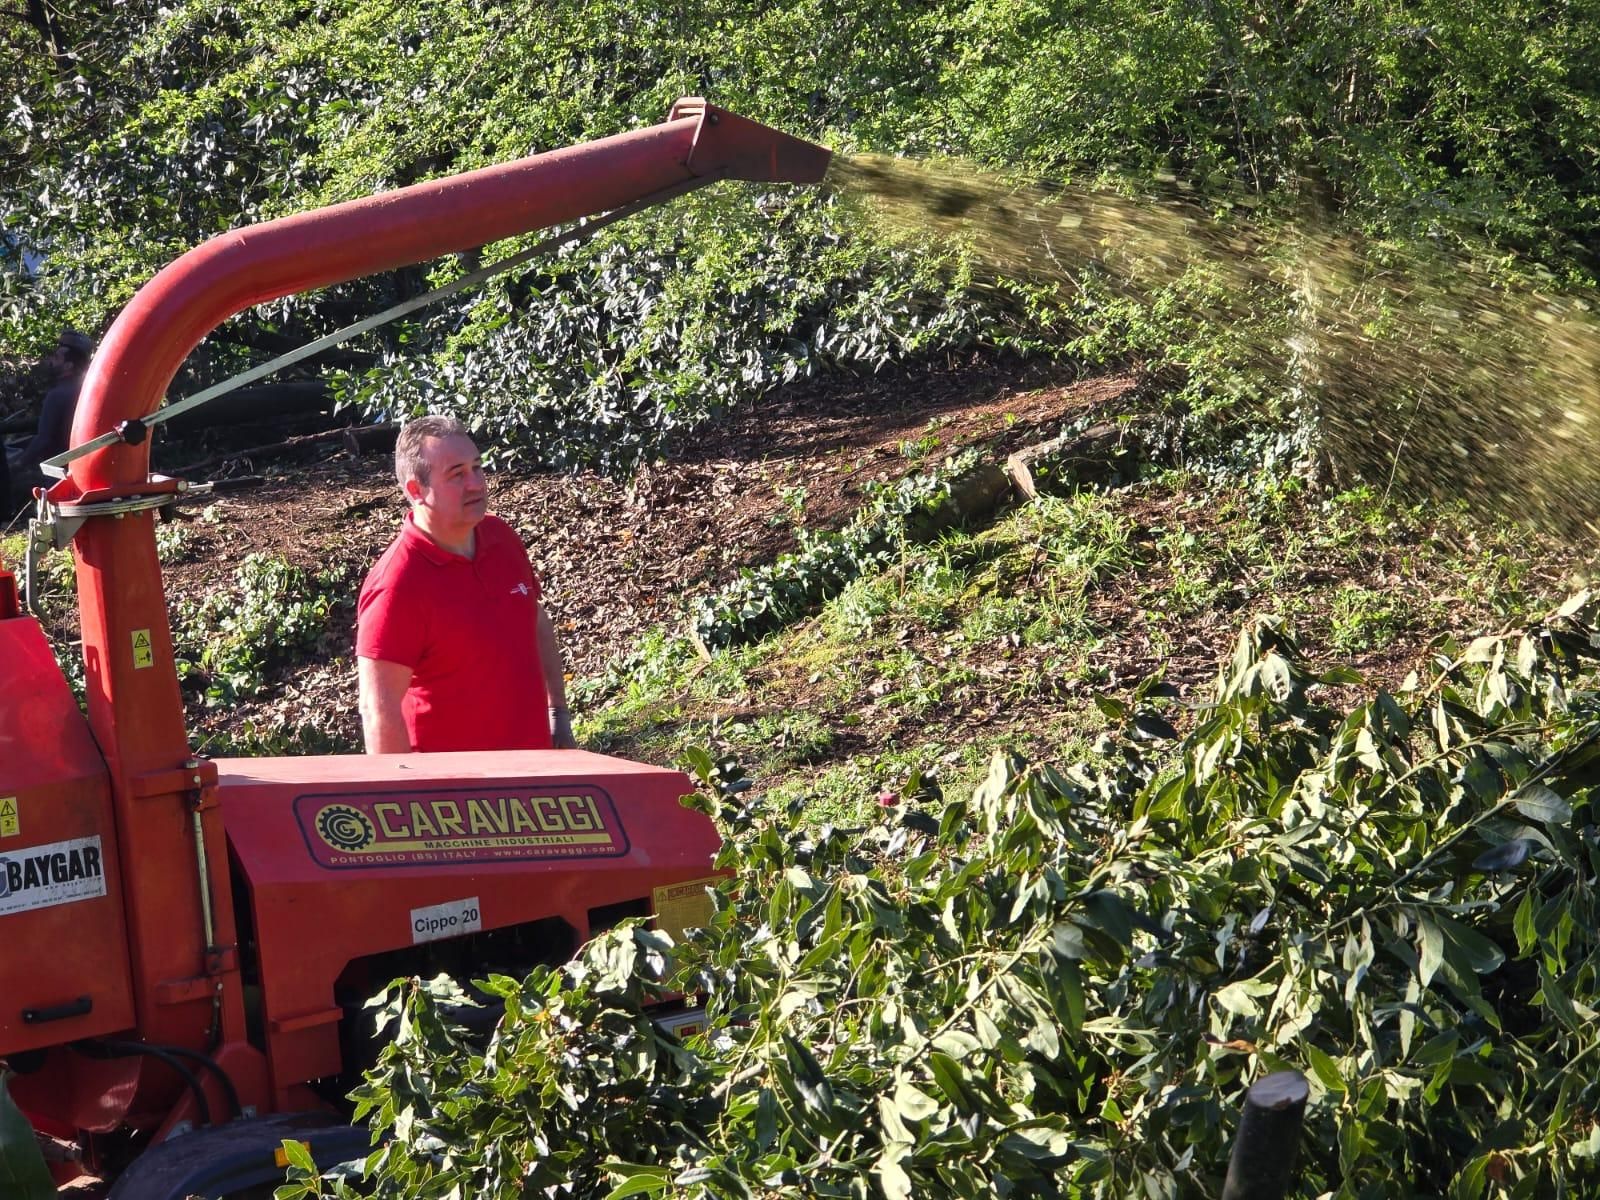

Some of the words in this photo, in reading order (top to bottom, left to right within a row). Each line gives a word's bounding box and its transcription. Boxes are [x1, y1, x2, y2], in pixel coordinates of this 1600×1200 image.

[373, 795, 606, 839] CARAVAGGI
[424, 838, 491, 849] MACCHINE
[496, 835, 575, 846] INDUSTRIALI
[330, 854, 407, 865] PONTOGLIO
[442, 850, 477, 859] ITALY
[494, 845, 616, 857] www.caravaggi.com
[6, 846, 101, 892] BAYGAR
[414, 916, 458, 933] Cippo
[462, 908, 478, 924] 20
